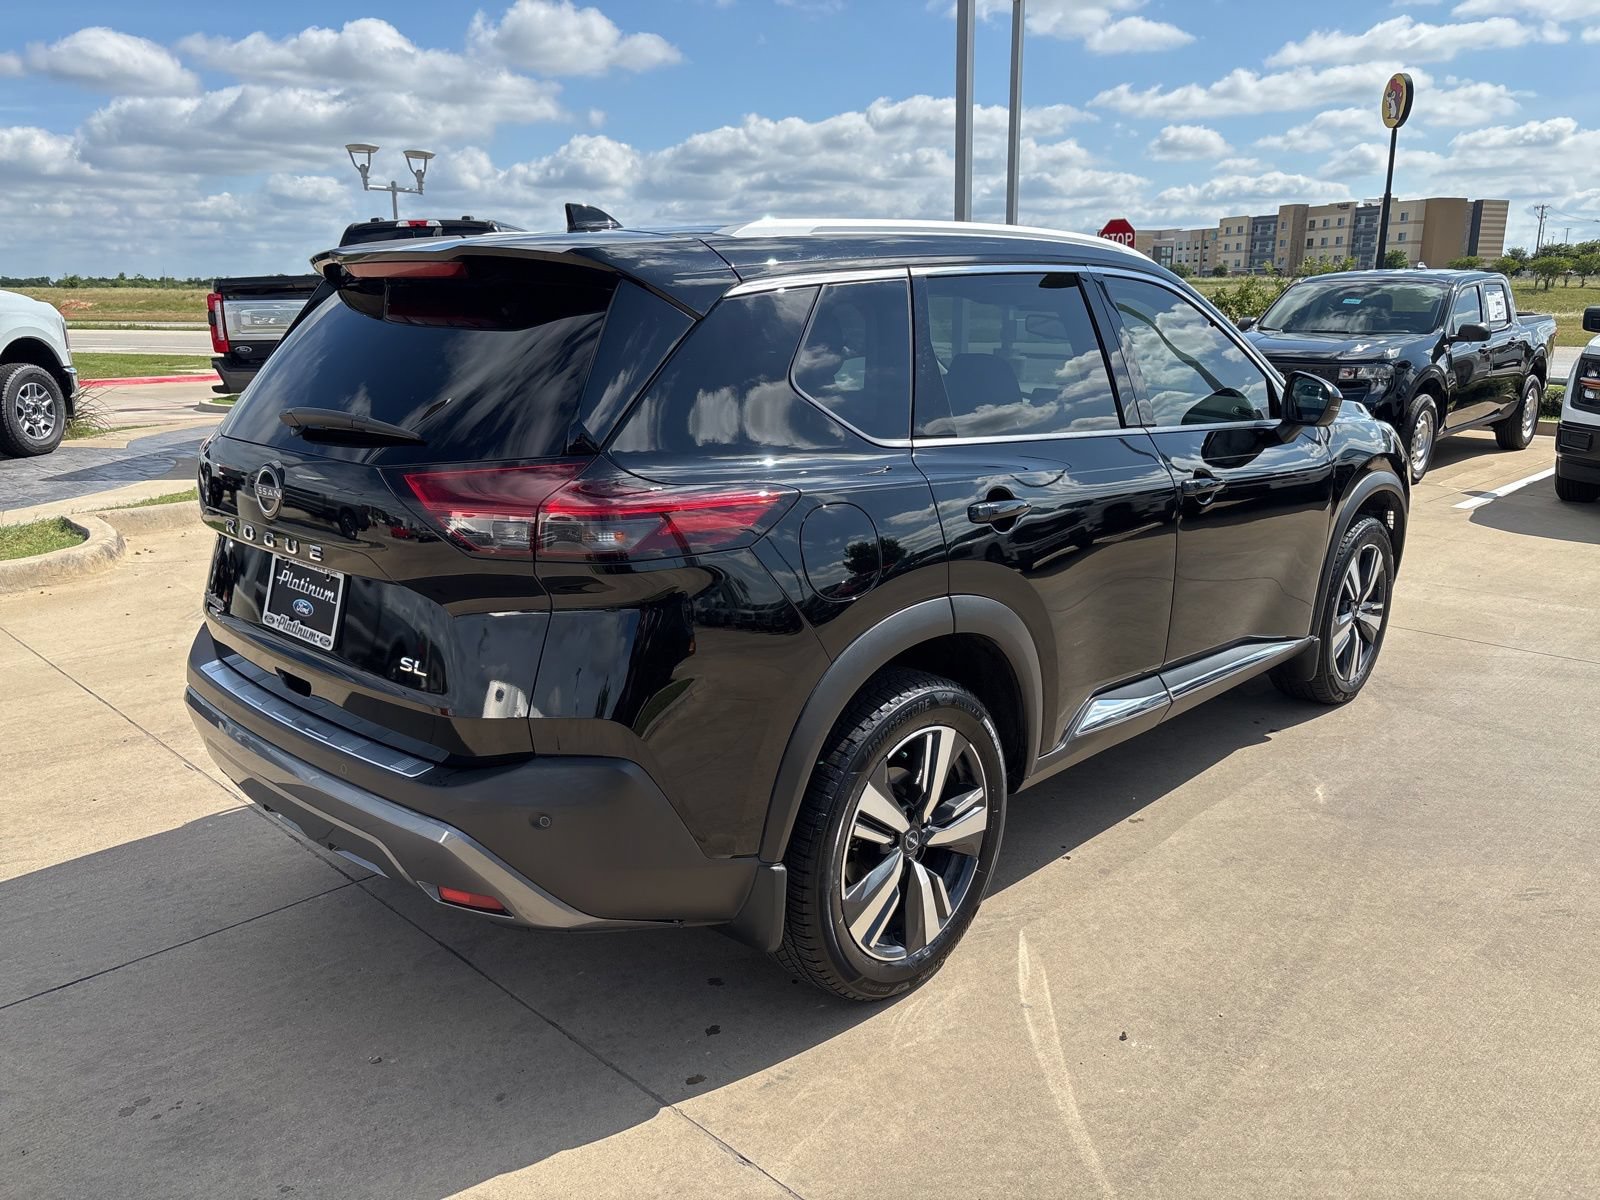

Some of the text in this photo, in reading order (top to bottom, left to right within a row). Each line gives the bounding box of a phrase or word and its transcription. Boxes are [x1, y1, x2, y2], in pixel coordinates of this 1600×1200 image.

[255, 485, 282, 498] SSAN
[225, 519, 323, 561] ROGUE
[276, 569, 337, 604] Platinum
[277, 615, 319, 643] Platinum
[400, 656, 427, 677] SL
